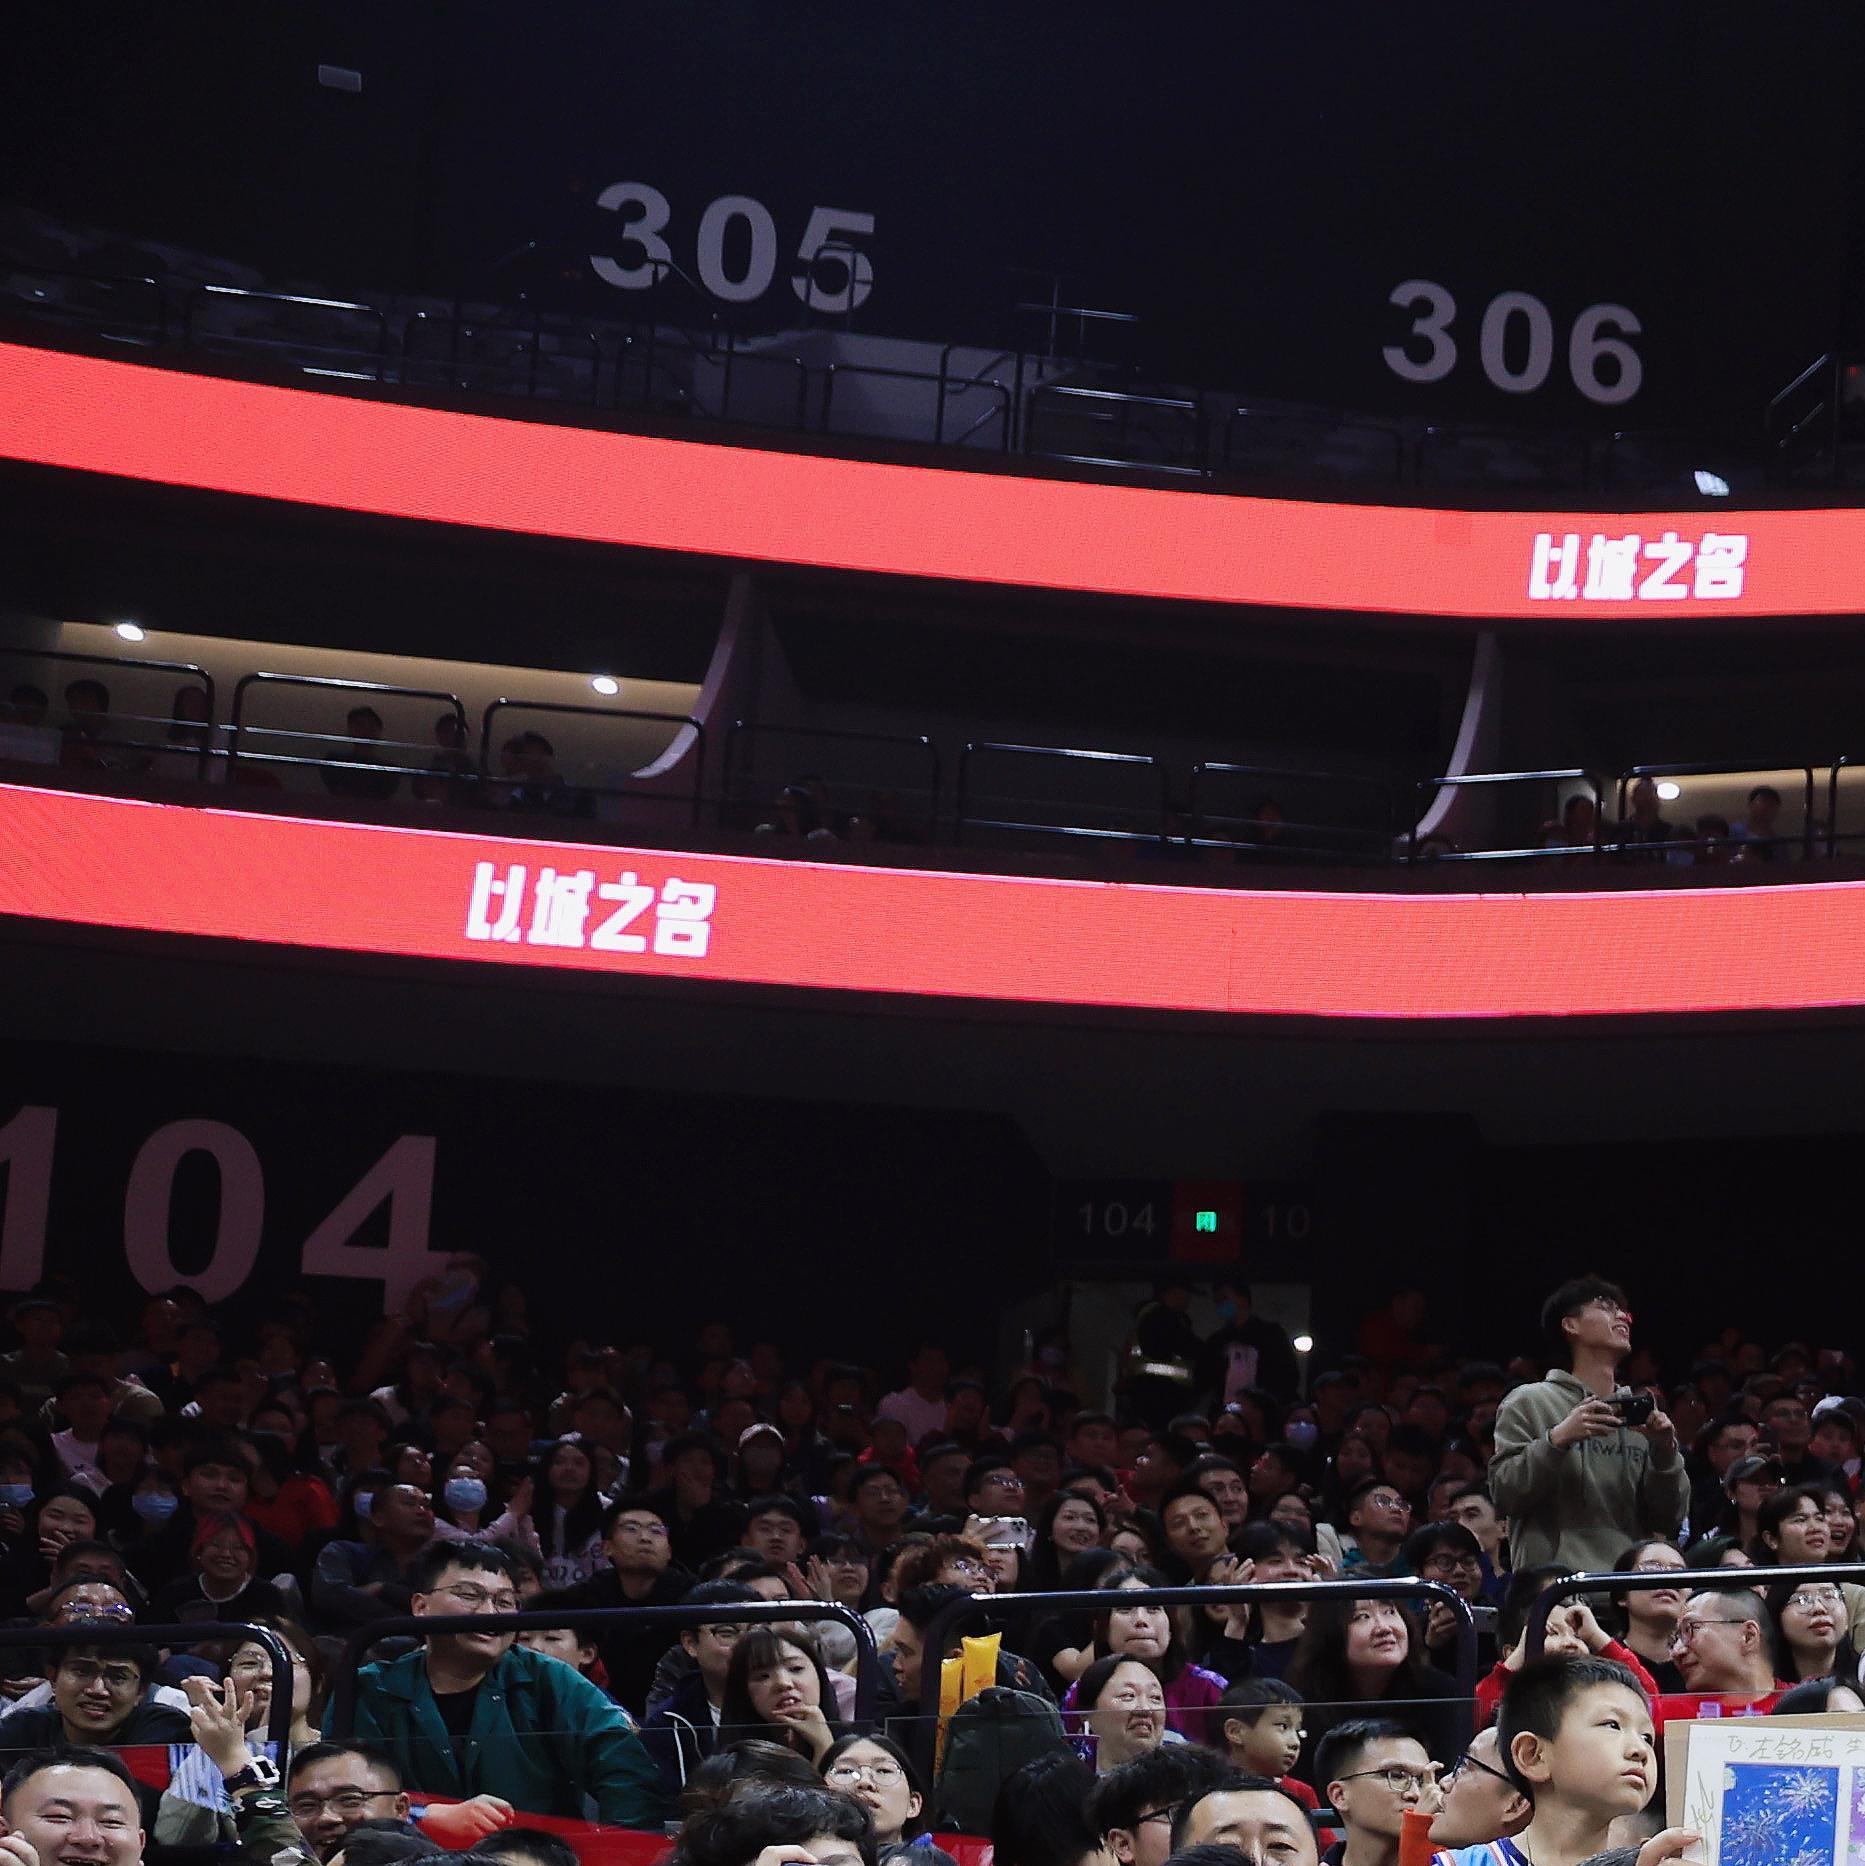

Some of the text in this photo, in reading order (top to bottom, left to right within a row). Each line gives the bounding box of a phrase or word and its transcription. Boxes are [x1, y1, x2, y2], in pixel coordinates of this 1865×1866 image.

[590, 182, 880, 315] 305
[1382, 279, 1644, 404] 306
[1528, 532, 1749, 601] 以城之名
[465, 860, 717, 958] 以城之名
[0, 1104, 453, 1365] 104
[1076, 1200, 1157, 1239] 104
[1258, 1203, 1310, 1239] 10
